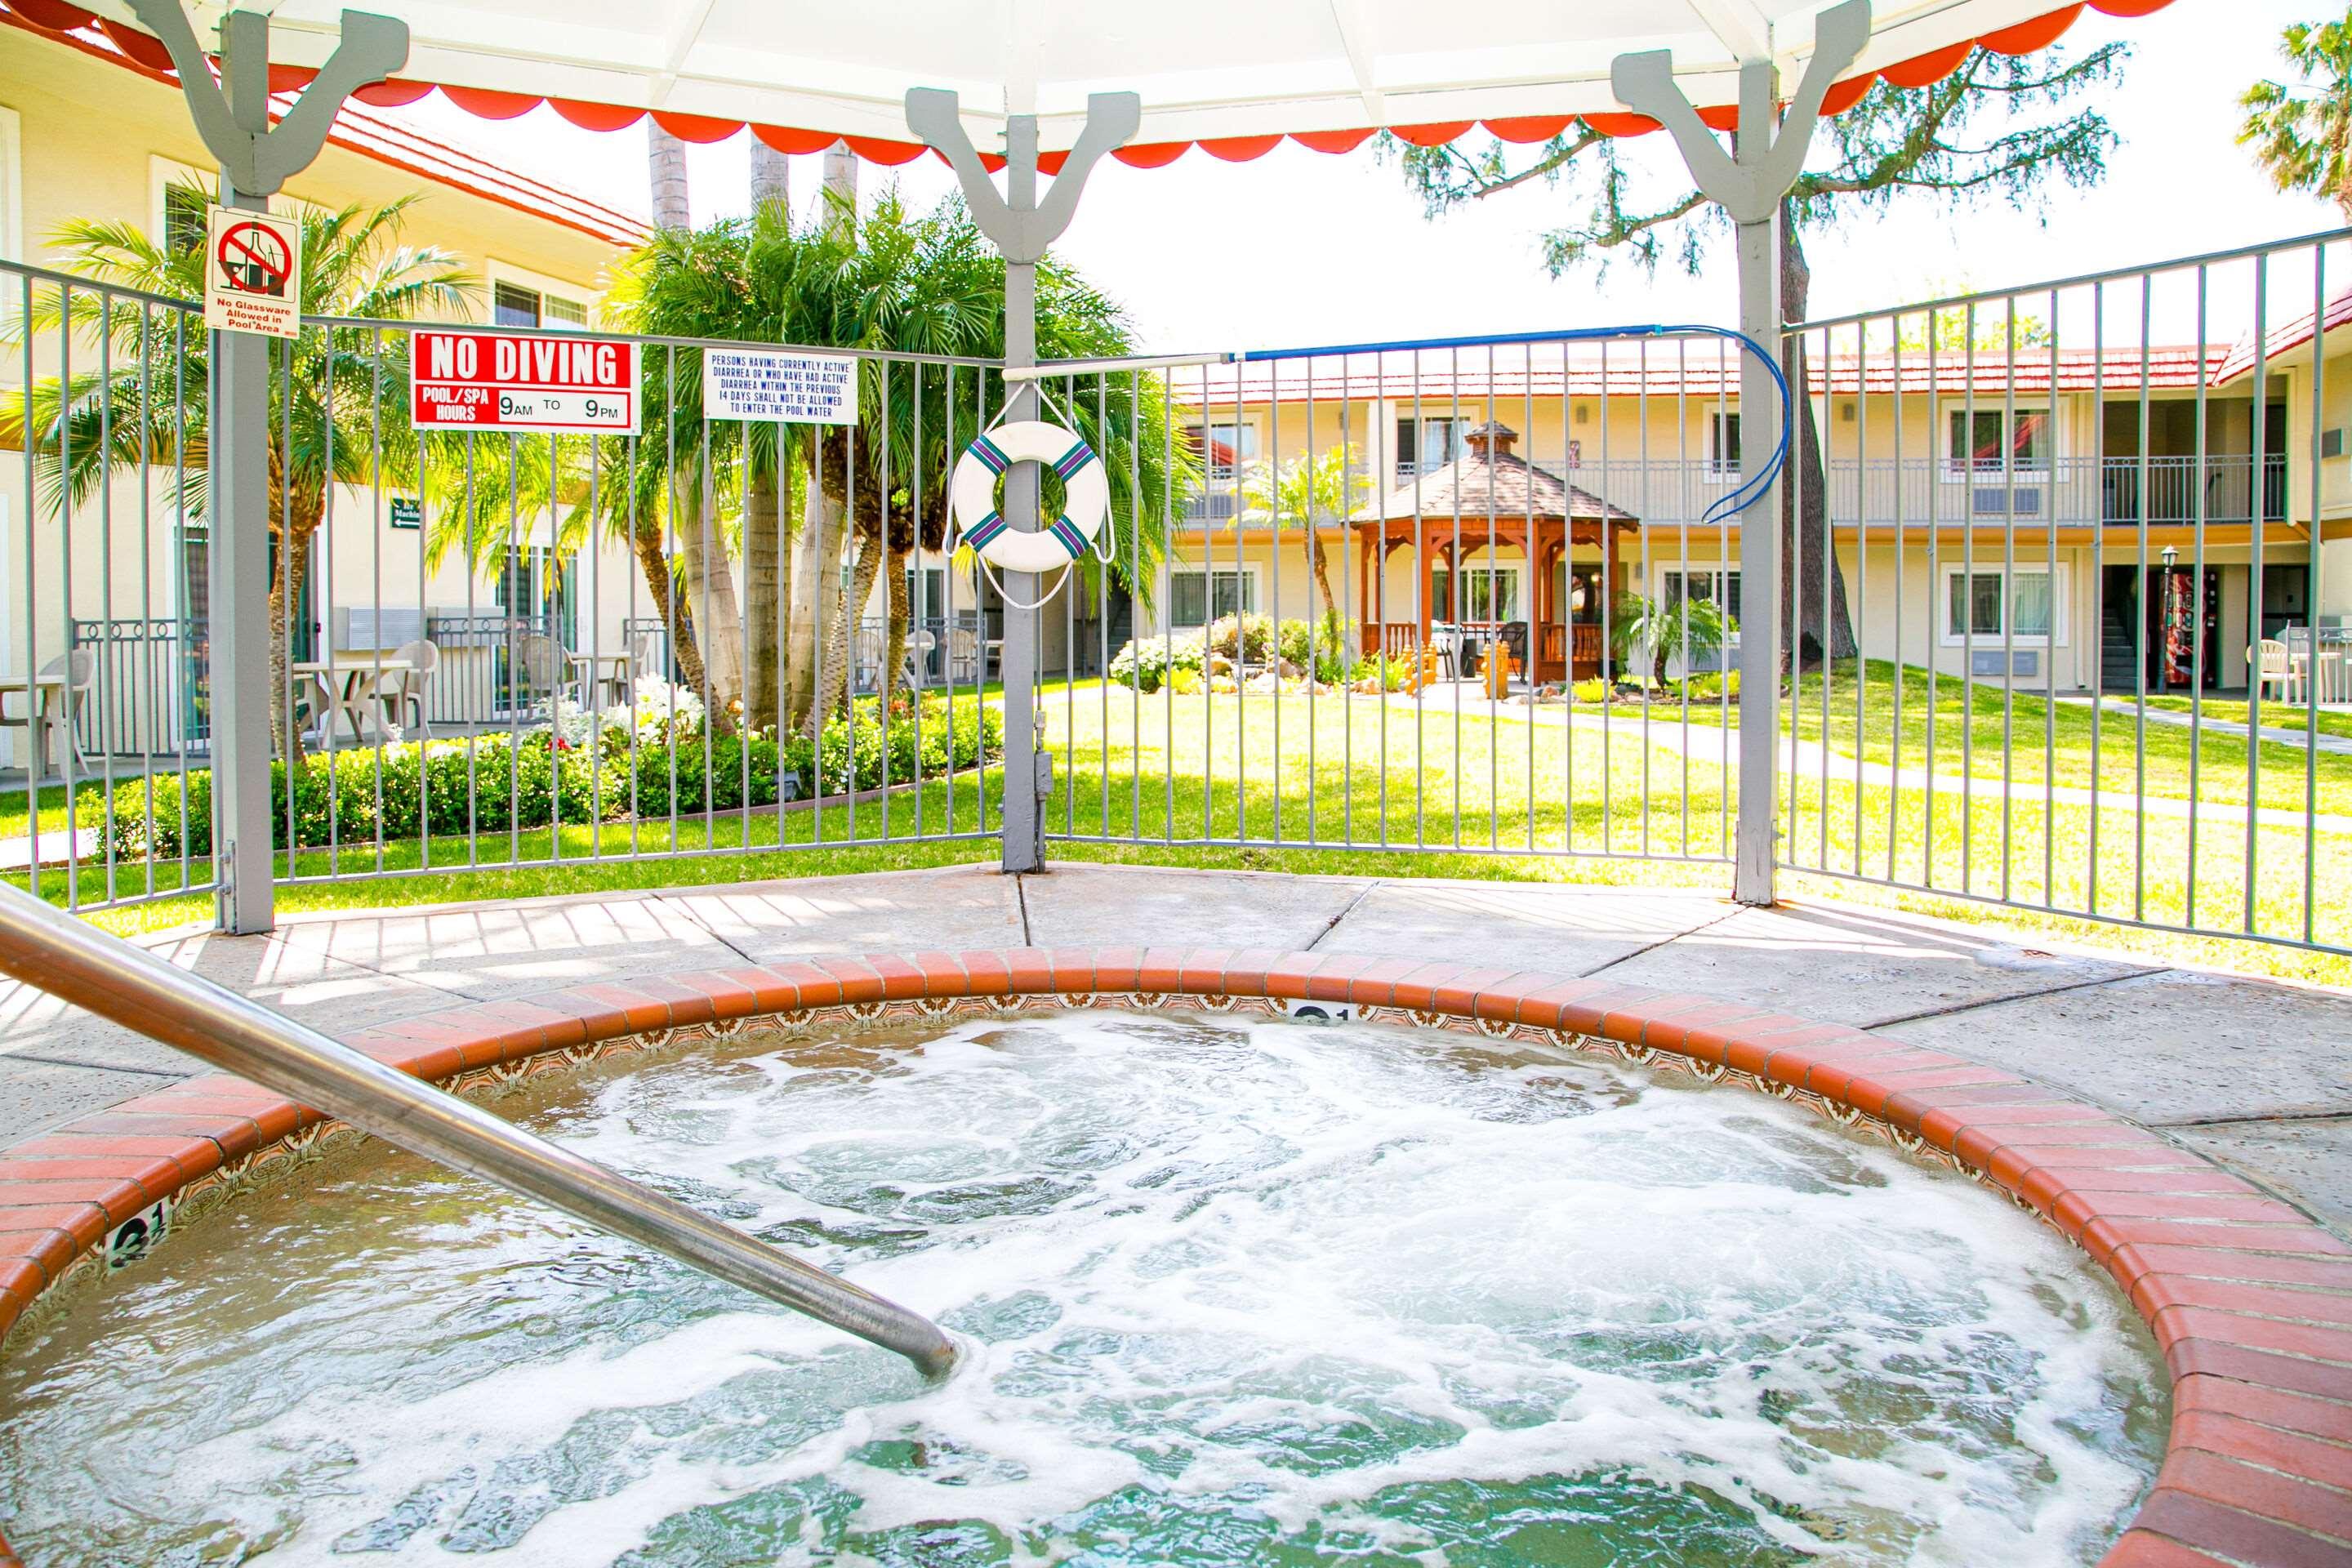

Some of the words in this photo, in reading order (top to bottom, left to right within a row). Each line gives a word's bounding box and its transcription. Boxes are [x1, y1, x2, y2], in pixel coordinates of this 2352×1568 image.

[217, 298, 232, 308] No
[235, 301, 292, 316] Glassware
[226, 309, 269, 323] Allowed
[272, 314, 282, 324] in
[228, 318, 252, 329] Pool
[255, 323, 279, 333] Area
[430, 336, 478, 380] NO
[495, 339, 617, 385] DIVING
[711, 354, 746, 367] PERSONS
[749, 357, 777, 368] HAVING
[779, 359, 821, 371] CURRENTLY
[823, 362, 850, 373] ACTIVE
[713, 367, 750, 378] DIARRHEA
[753, 369, 762, 379] OR
[765, 370, 782, 380] WHO
[783, 372, 803, 381] HAVE
[805, 372, 820, 383] HAD
[822, 373, 849, 385] ACTIVE
[422, 386, 489, 405] POOL/SPA
[720, 379, 758, 390] DIARRHEA
[760, 381, 787, 392] WITHIN
[790, 383, 804, 393] THE
[806, 384, 841, 395] PREVIOUS
[543, 399, 561, 411] TO
[719, 390, 728, 400] 14
[730, 391, 751, 402] DAYS
[754, 392, 777, 403] SHALL
[780, 394, 794, 404] NOT
[797, 395, 806, 404] BE
[808, 395, 843, 407] ALLOWED
[436, 404, 476, 422] HOURS
[730, 403, 740, 412] TO
[742, 403, 766, 414] ENTER
[770, 404, 783, 415] THE
[786, 406, 804, 416] POOL
[807, 407, 832, 417] WATER
